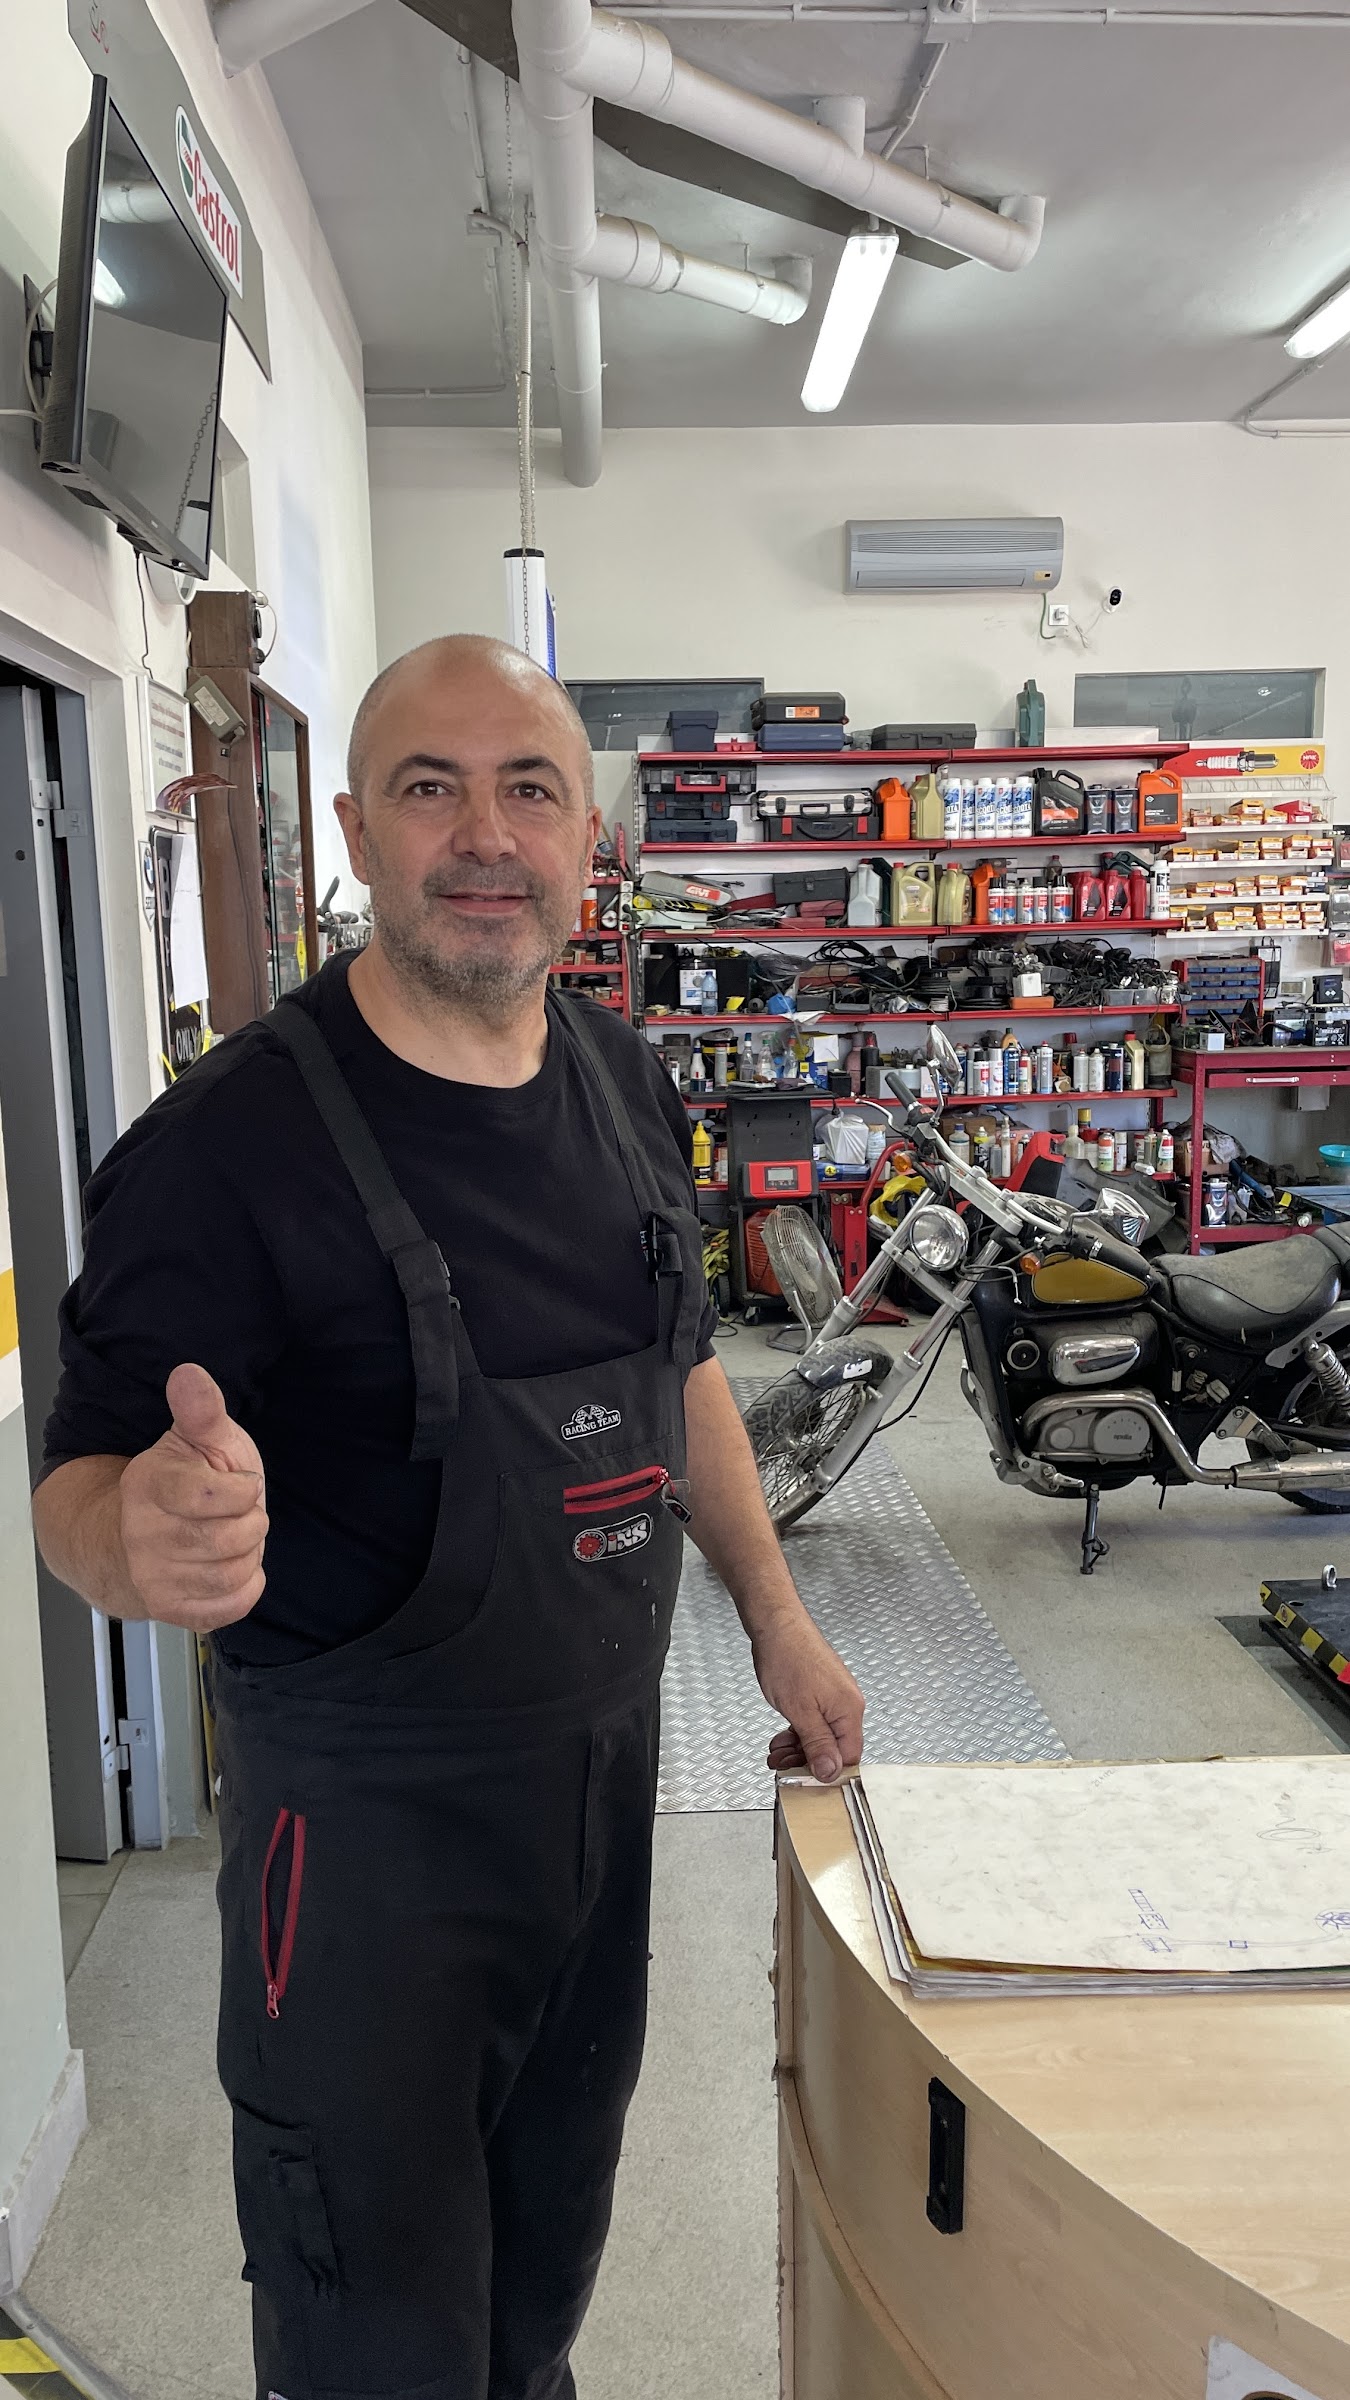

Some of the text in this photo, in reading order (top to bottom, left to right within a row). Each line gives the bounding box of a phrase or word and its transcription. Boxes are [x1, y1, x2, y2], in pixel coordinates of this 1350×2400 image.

[194, 150, 240, 283] Castrol
[176, 1026, 198, 1063] ONLY
[565, 1414, 619, 1436] RACING TEAM
